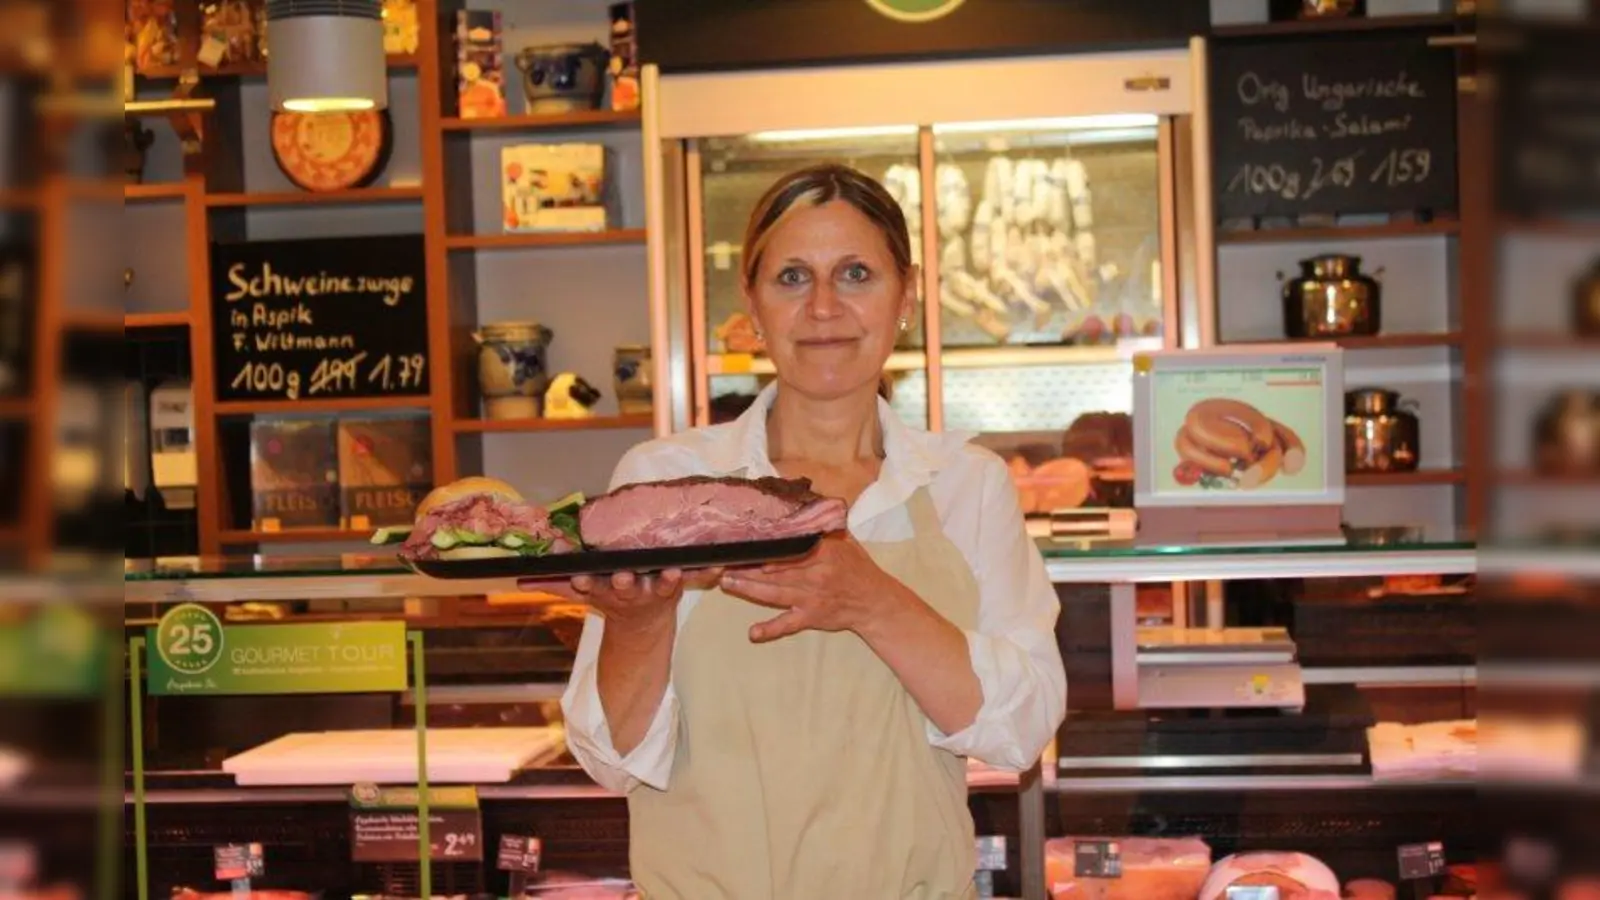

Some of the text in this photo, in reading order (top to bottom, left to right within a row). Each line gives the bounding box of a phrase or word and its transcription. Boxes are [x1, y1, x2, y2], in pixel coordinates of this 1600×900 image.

[231, 303, 314, 329] in Aspik
[255, 332, 354, 351] Wiltmann
[169, 623, 214, 655] 25
[230, 642, 395, 665] GOURMET TOUR
